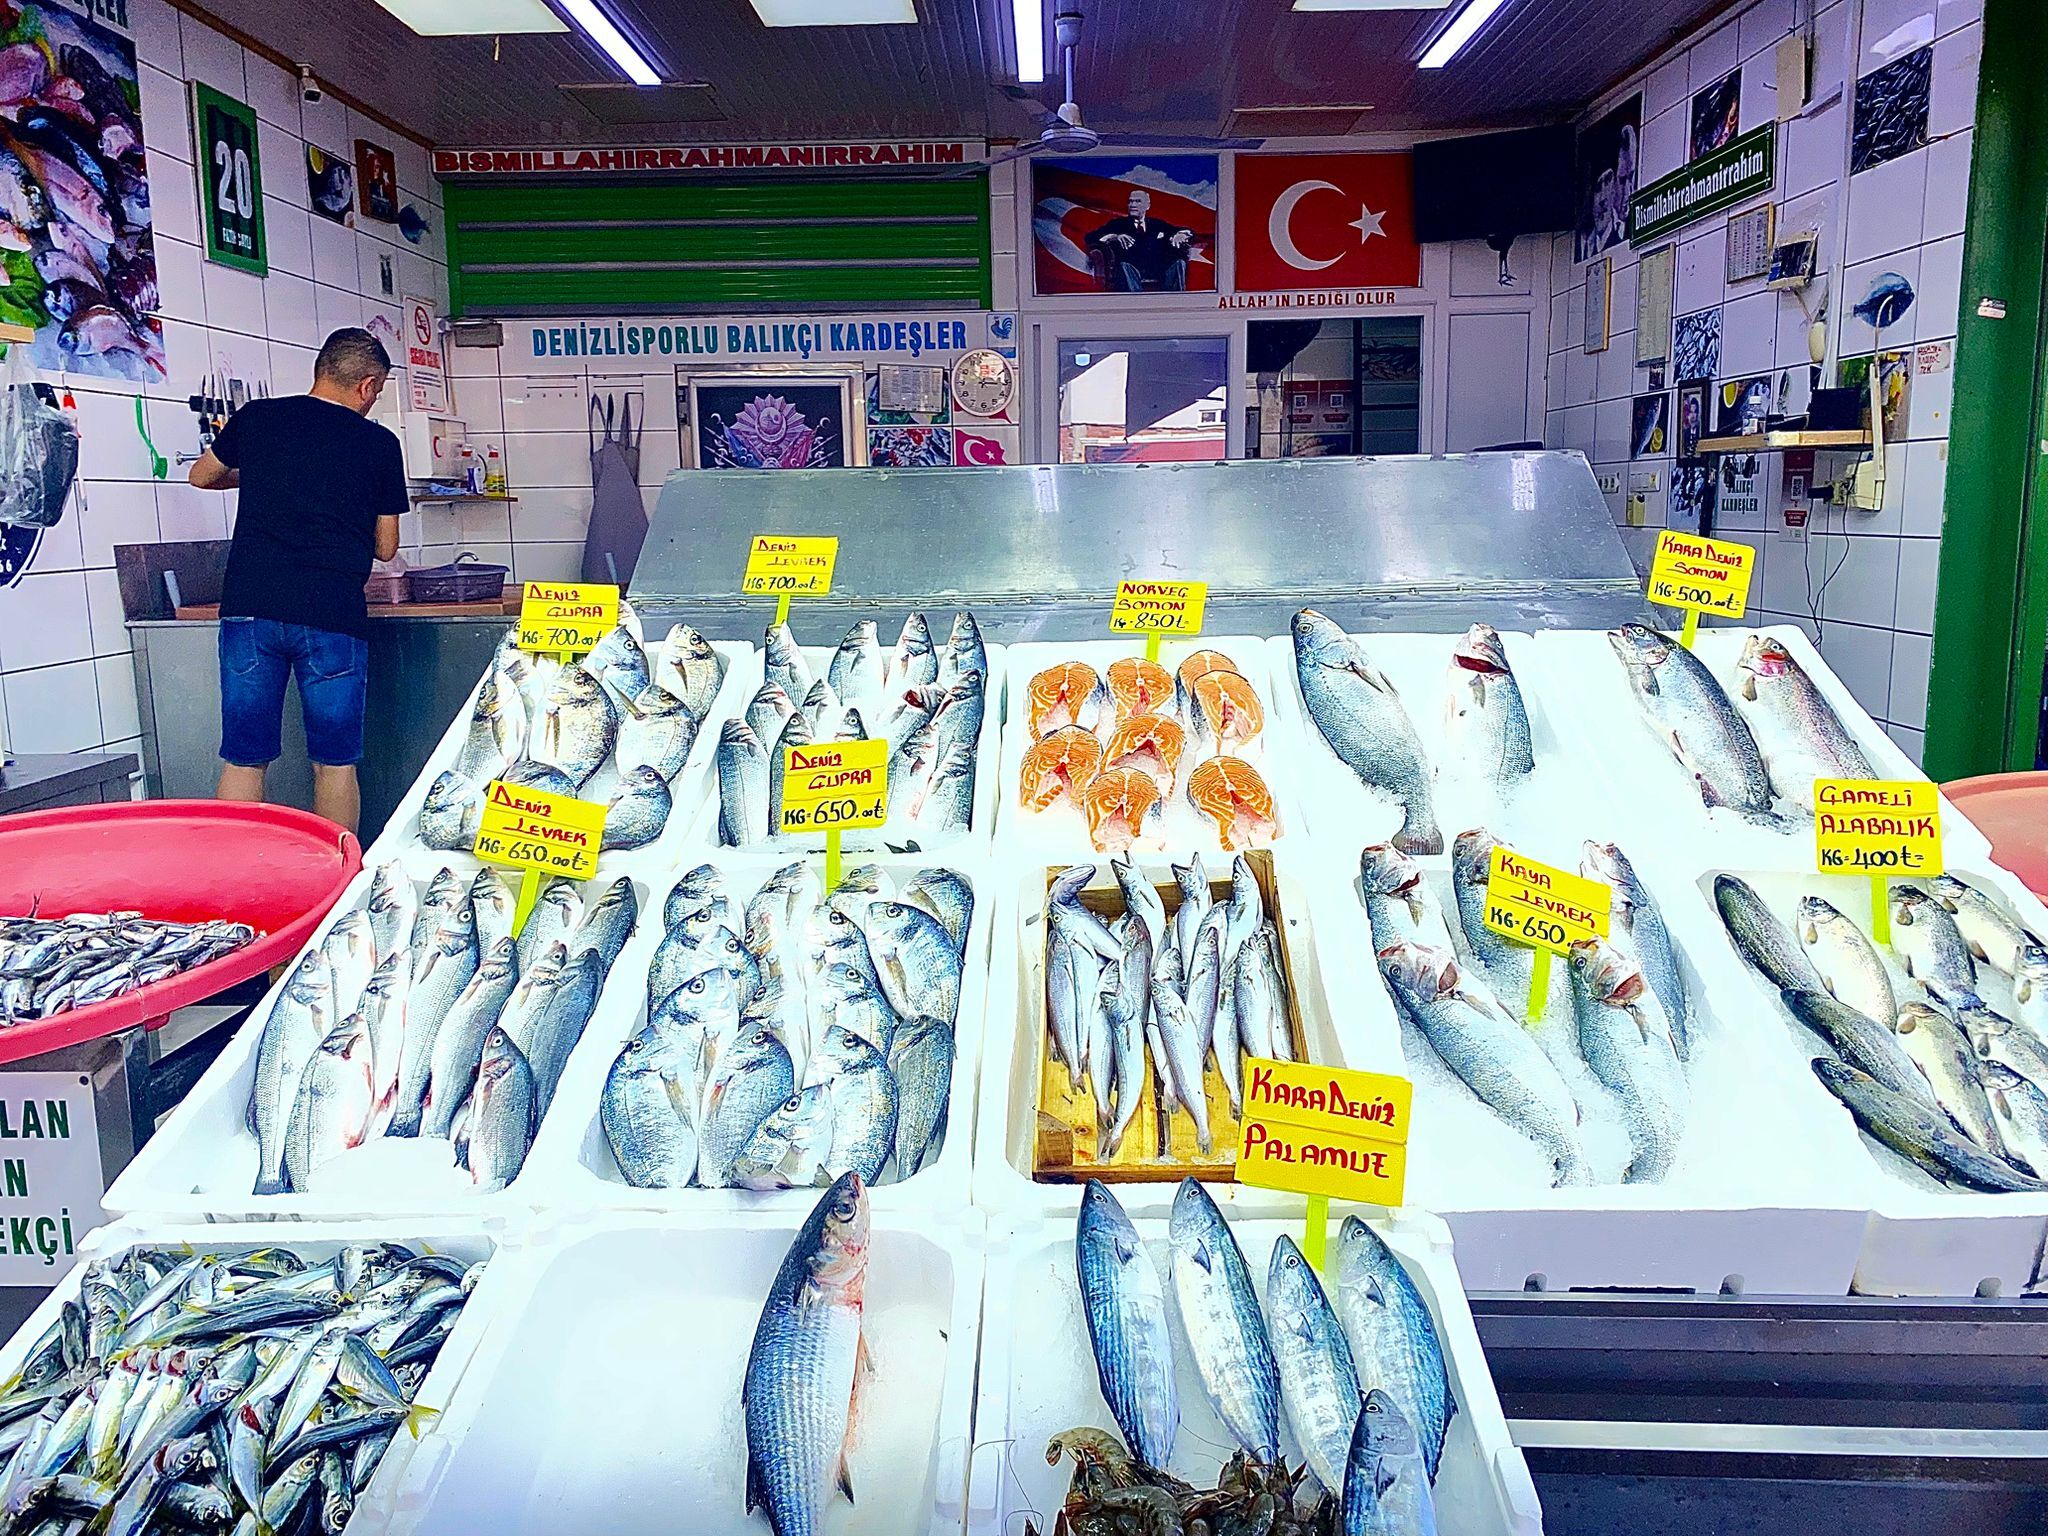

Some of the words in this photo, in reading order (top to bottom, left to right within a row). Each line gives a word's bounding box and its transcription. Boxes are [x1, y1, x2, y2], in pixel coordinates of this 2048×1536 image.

[215, 140, 253, 219] 20
[1634, 149, 1764, 231] Bismillahirrahmanirrahim
[1355, 291, 1396, 305] OLUR
[532, 321, 718, 356] DENİZLİSPORLU
[726, 323, 822, 359] BALIKÇI
[830, 321, 967, 358] KARDEŞLER
[1666, 561, 1728, 582] SOMON
[1114, 598, 1186, 611] SOMON
[502, 817, 587, 847] LEVREK
[1820, 814, 1935, 838] ALABALIK
[1500, 854, 1551, 890] KAYA
[1510, 889, 1596, 929] LEVREK
